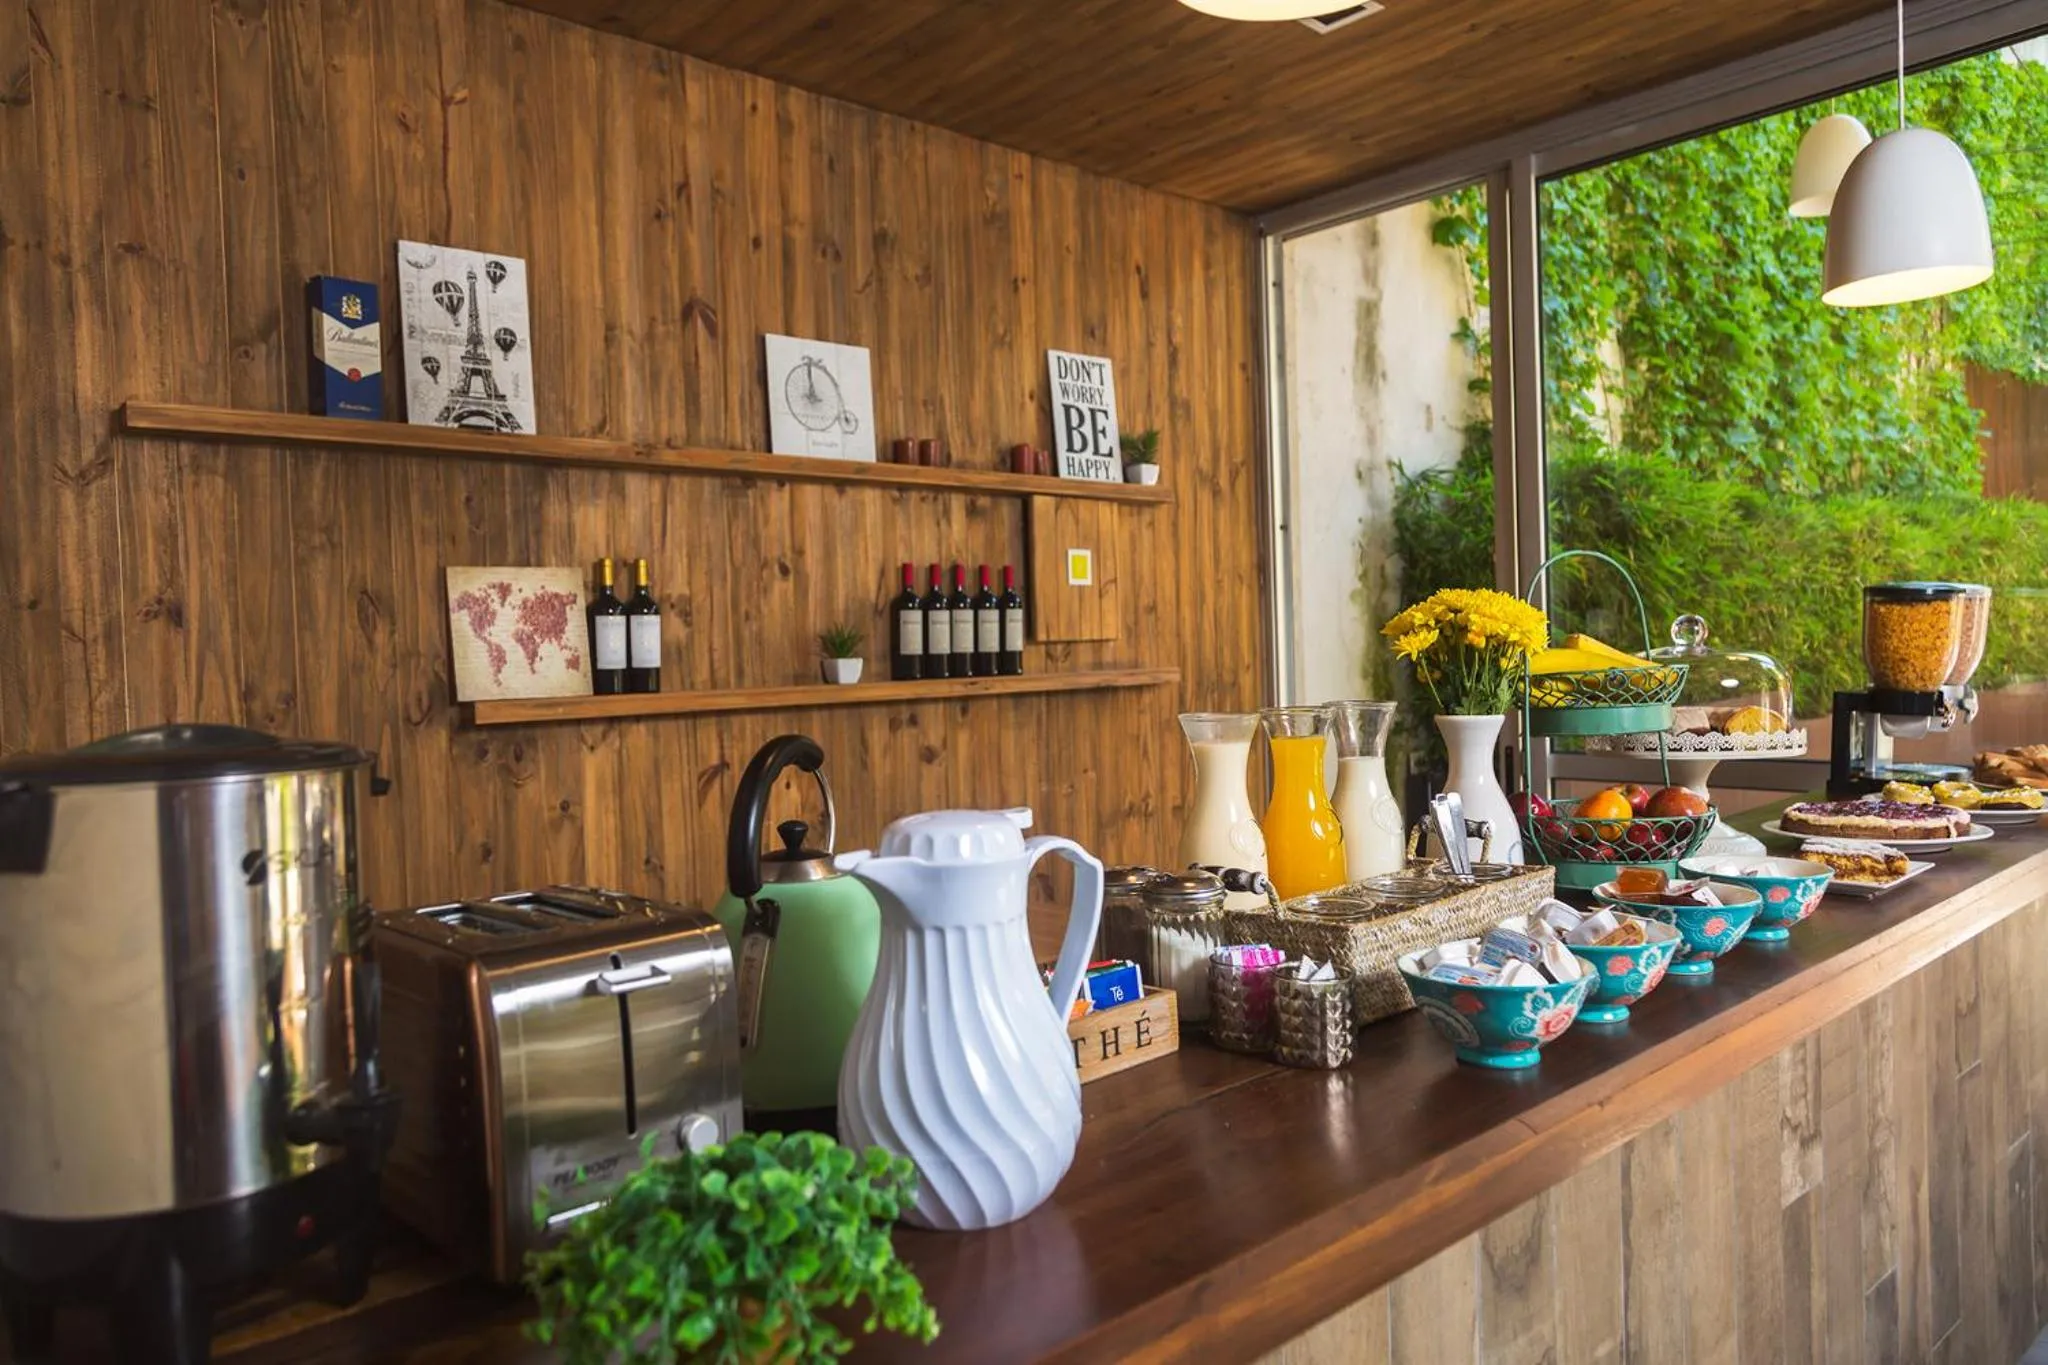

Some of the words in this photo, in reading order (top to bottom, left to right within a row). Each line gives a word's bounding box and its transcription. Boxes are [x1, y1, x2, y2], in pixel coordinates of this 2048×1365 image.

[1057, 355, 1106, 387] DON'T
[1061, 403, 1114, 459] BE
[1109, 984, 1125, 1003] Té
[1071, 1010, 1153, 1069] THÉ
